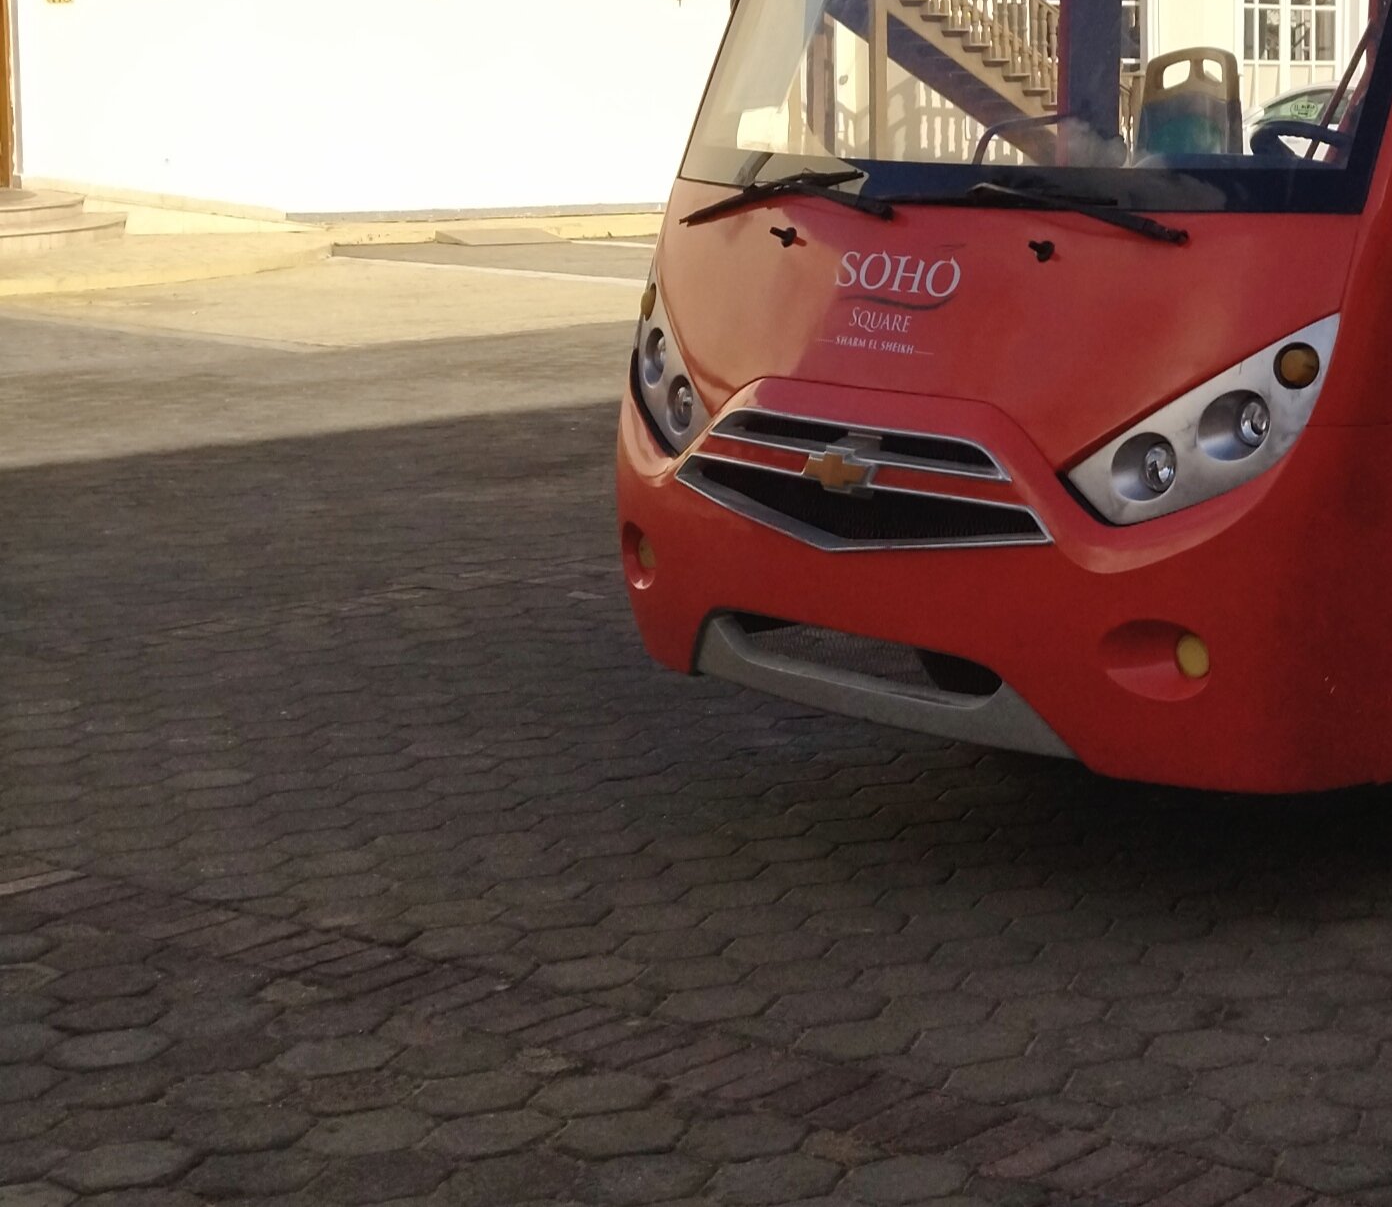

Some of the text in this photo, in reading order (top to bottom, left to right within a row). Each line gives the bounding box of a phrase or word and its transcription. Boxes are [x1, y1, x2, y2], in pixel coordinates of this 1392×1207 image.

[835, 250, 961, 298] SOHO
[849, 306, 912, 333] SQUARE
[835, 335, 914, 354] SHARM EL SHEIKH
